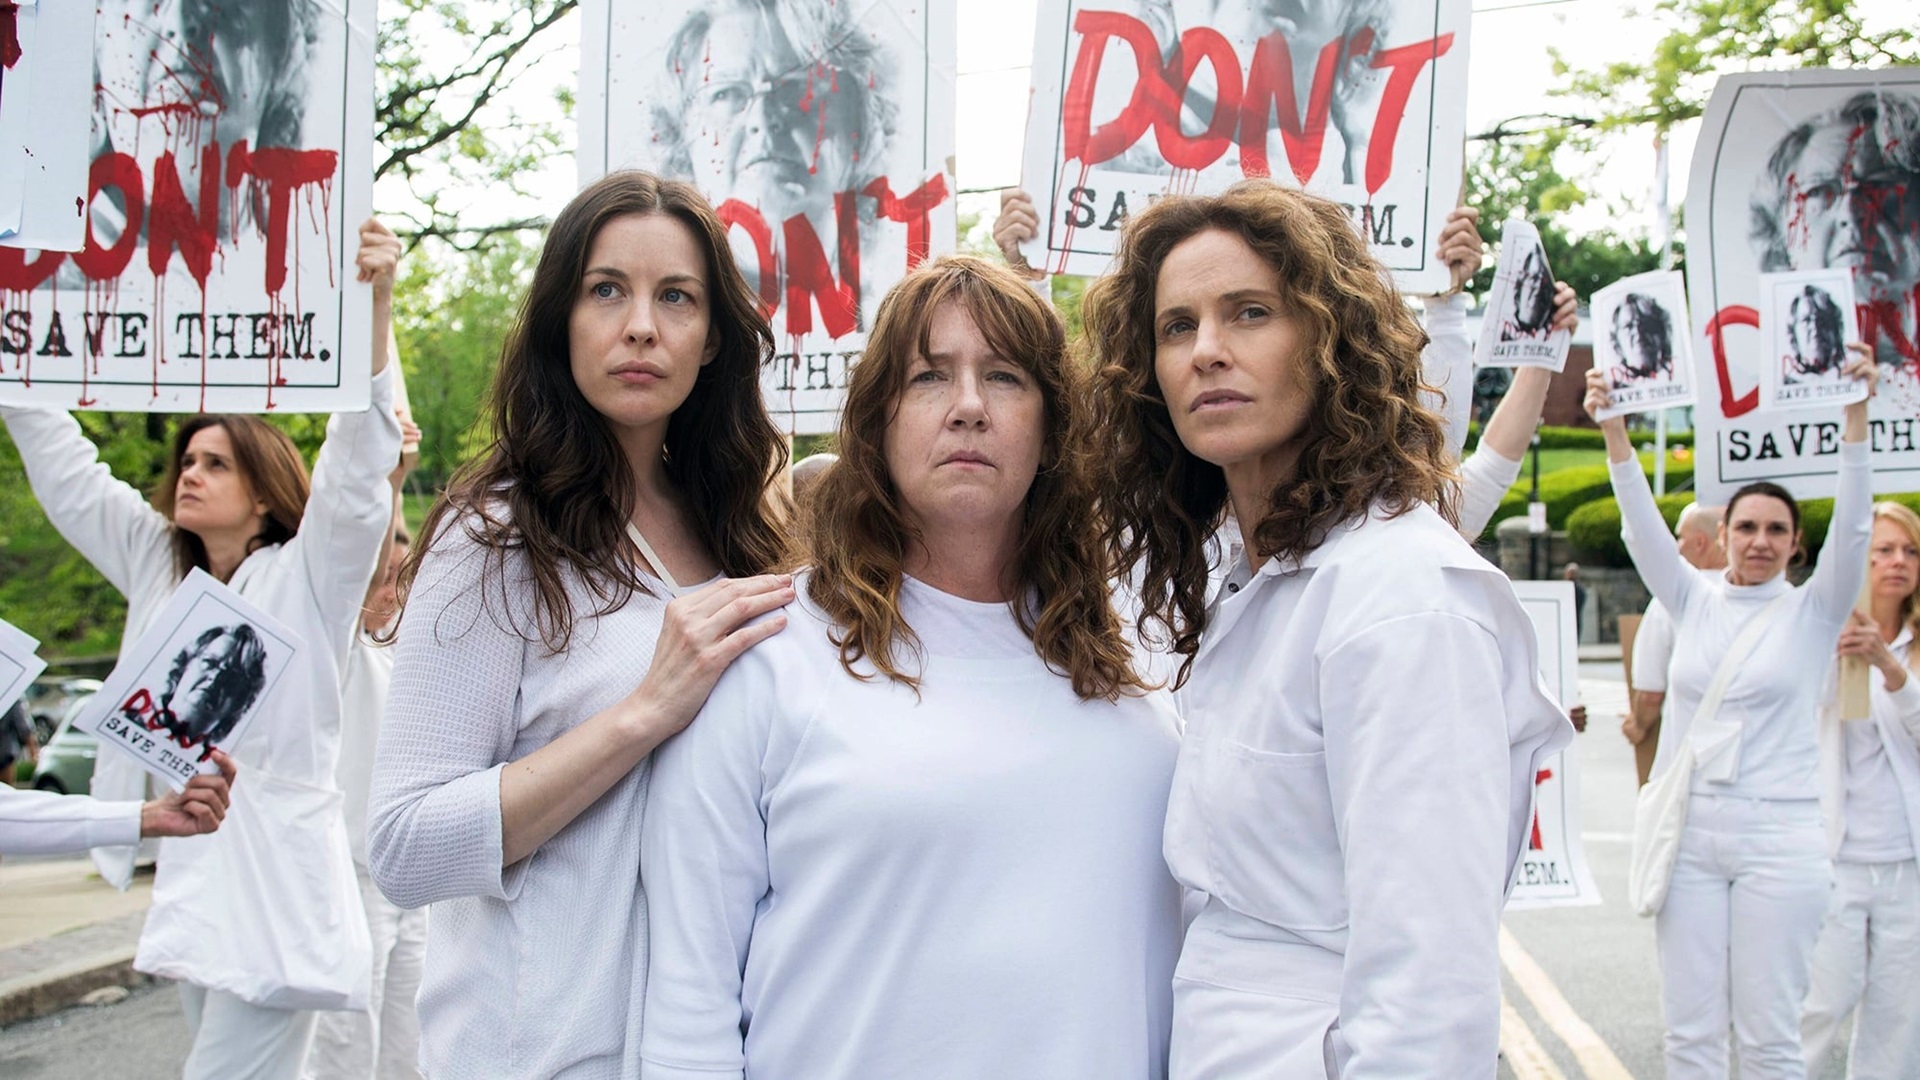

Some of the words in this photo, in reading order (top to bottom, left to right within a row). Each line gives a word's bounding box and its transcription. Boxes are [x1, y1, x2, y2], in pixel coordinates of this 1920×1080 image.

[1063, 9, 1455, 195] DON'T
[715, 173, 949, 340] ON'T
[2, 310, 148, 357] SAVE
[176, 312, 331, 362] THEM.
[1729, 422, 1839, 462] SAVE
[106, 717, 155, 754] SAVE
[159, 748, 200, 778] THE
[1516, 862, 1569, 886] EM.
